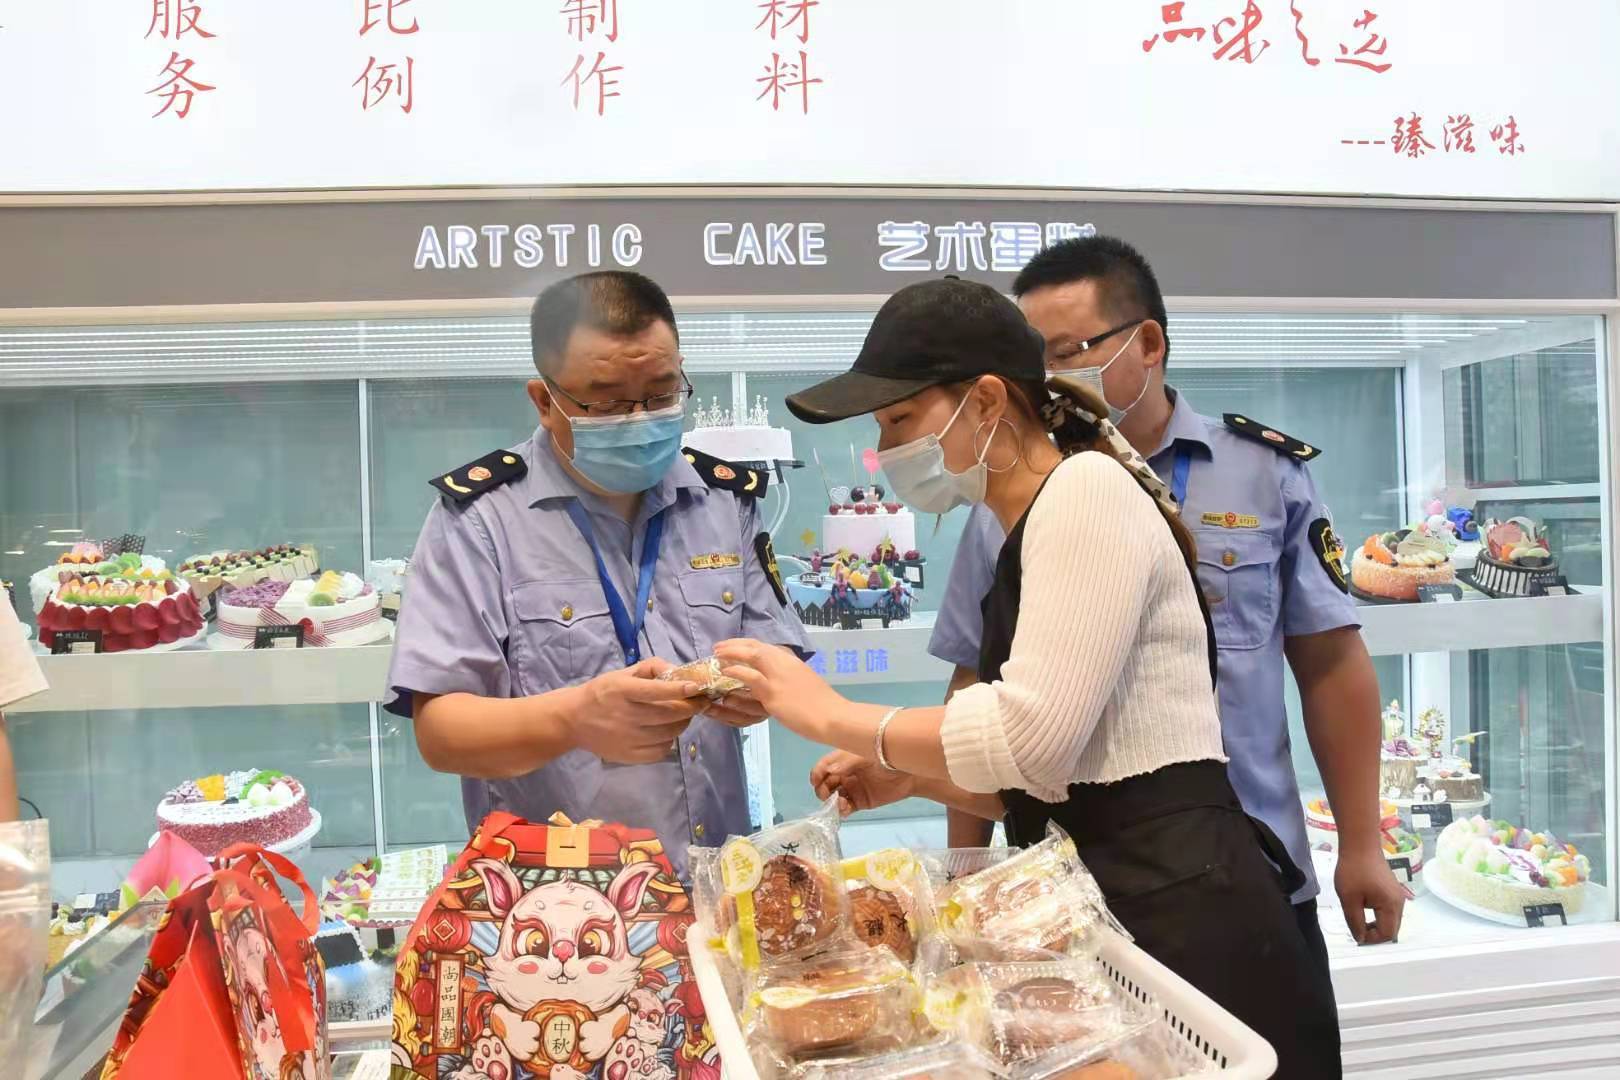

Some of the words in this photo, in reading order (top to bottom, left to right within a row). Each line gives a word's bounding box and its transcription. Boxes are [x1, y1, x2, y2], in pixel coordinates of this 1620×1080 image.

[414, 223, 644, 269] ARTSTIC
[703, 222, 828, 266] CAKE
[552, 1019, 571, 1054] 中秋
